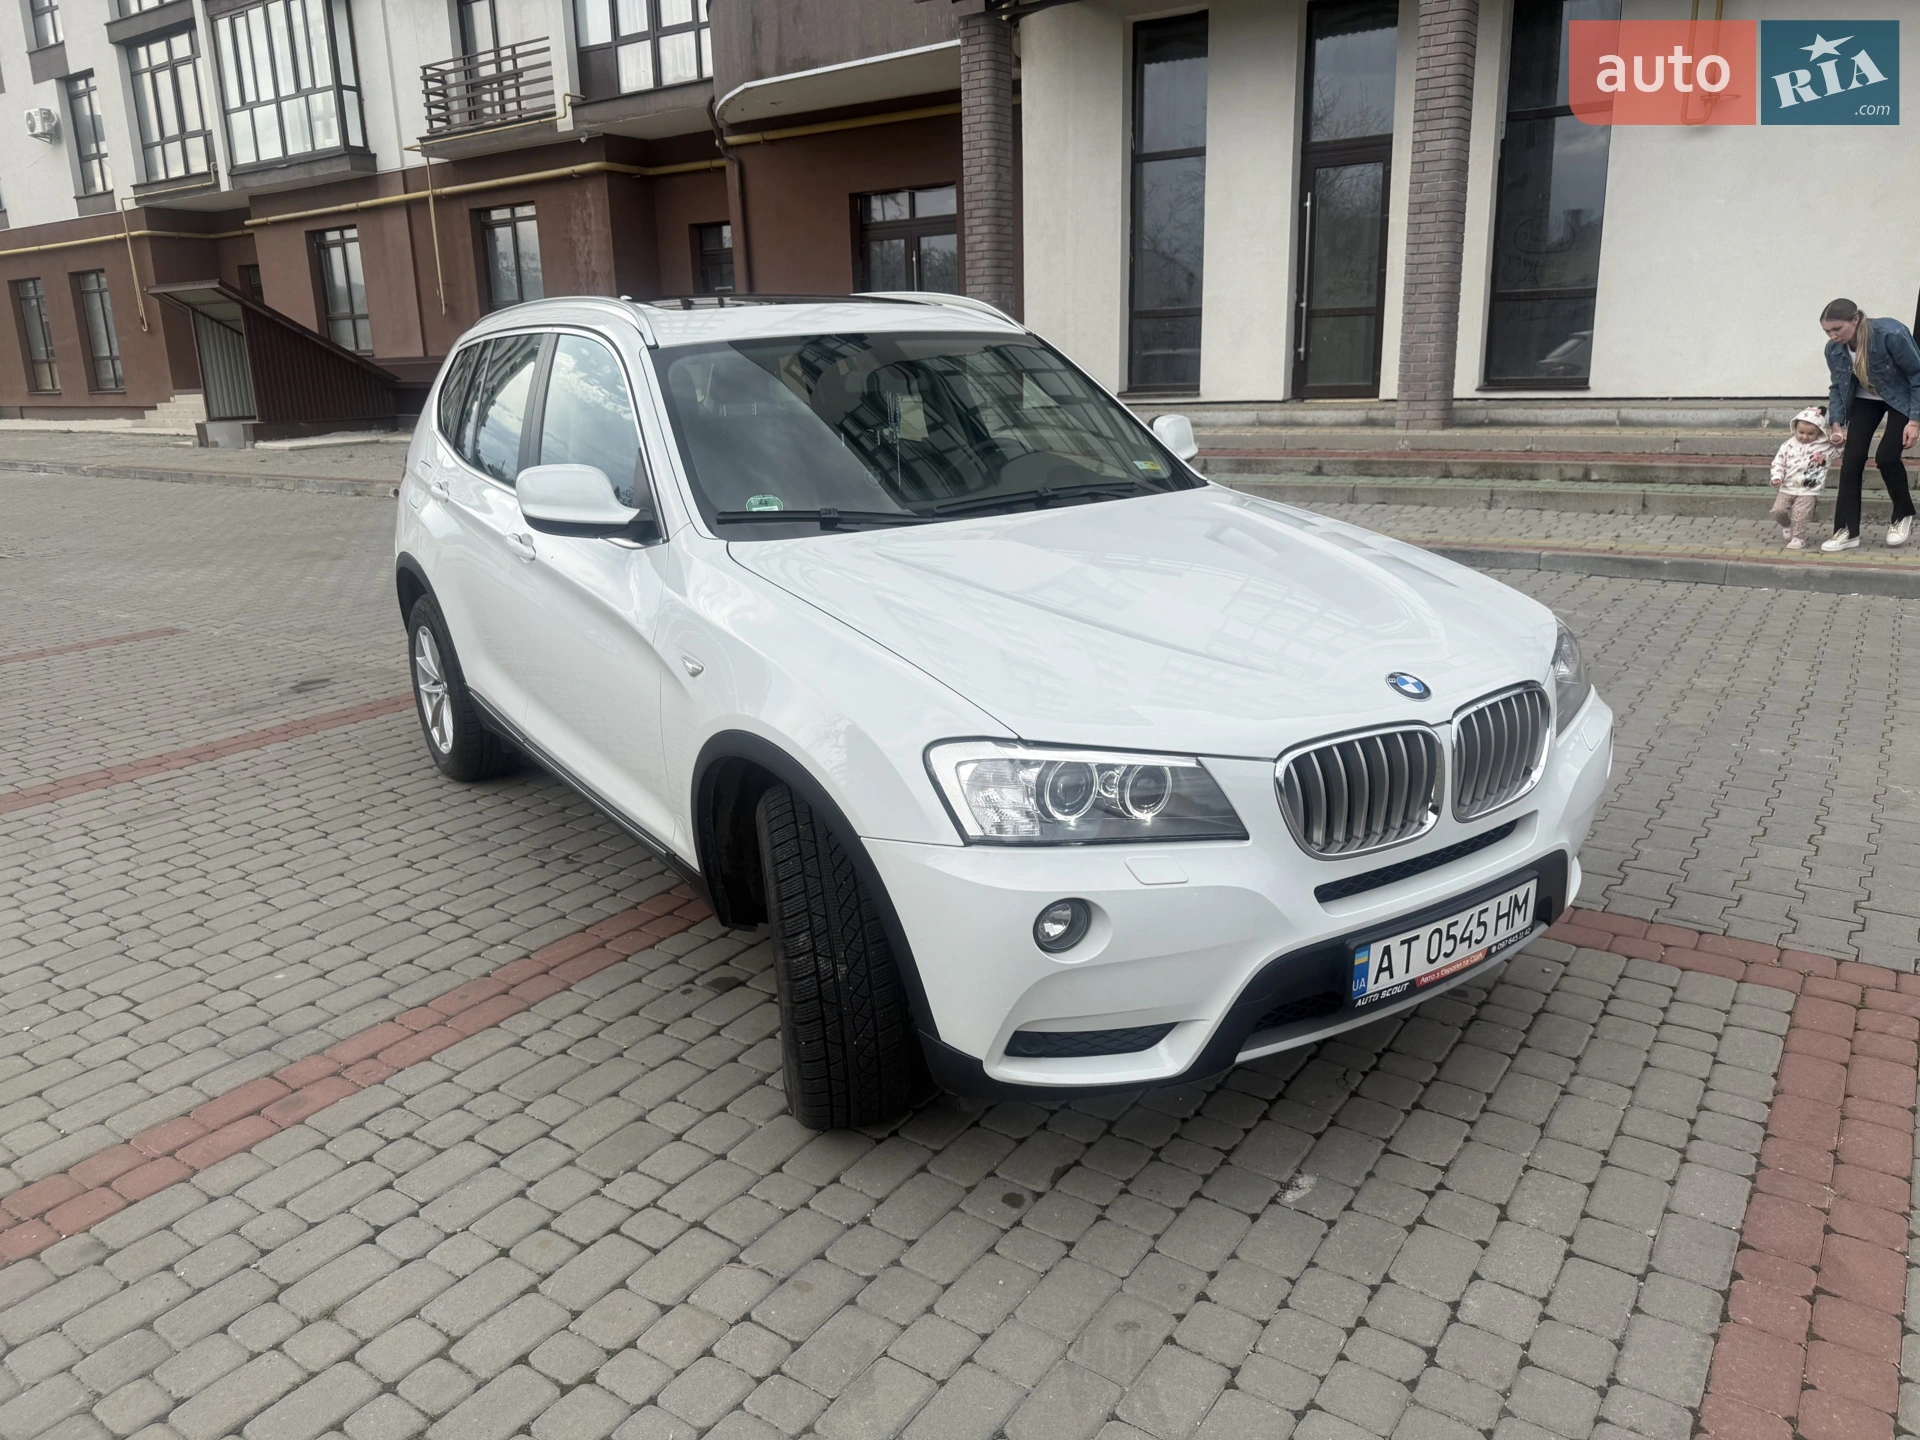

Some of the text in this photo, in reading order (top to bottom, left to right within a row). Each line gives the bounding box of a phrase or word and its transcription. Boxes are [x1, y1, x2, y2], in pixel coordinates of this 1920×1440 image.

[1373, 887, 1530, 985] AT 0545 HM
[1352, 977, 1366, 992] UA
[1354, 982, 1410, 1008] AUTO SCOUT
